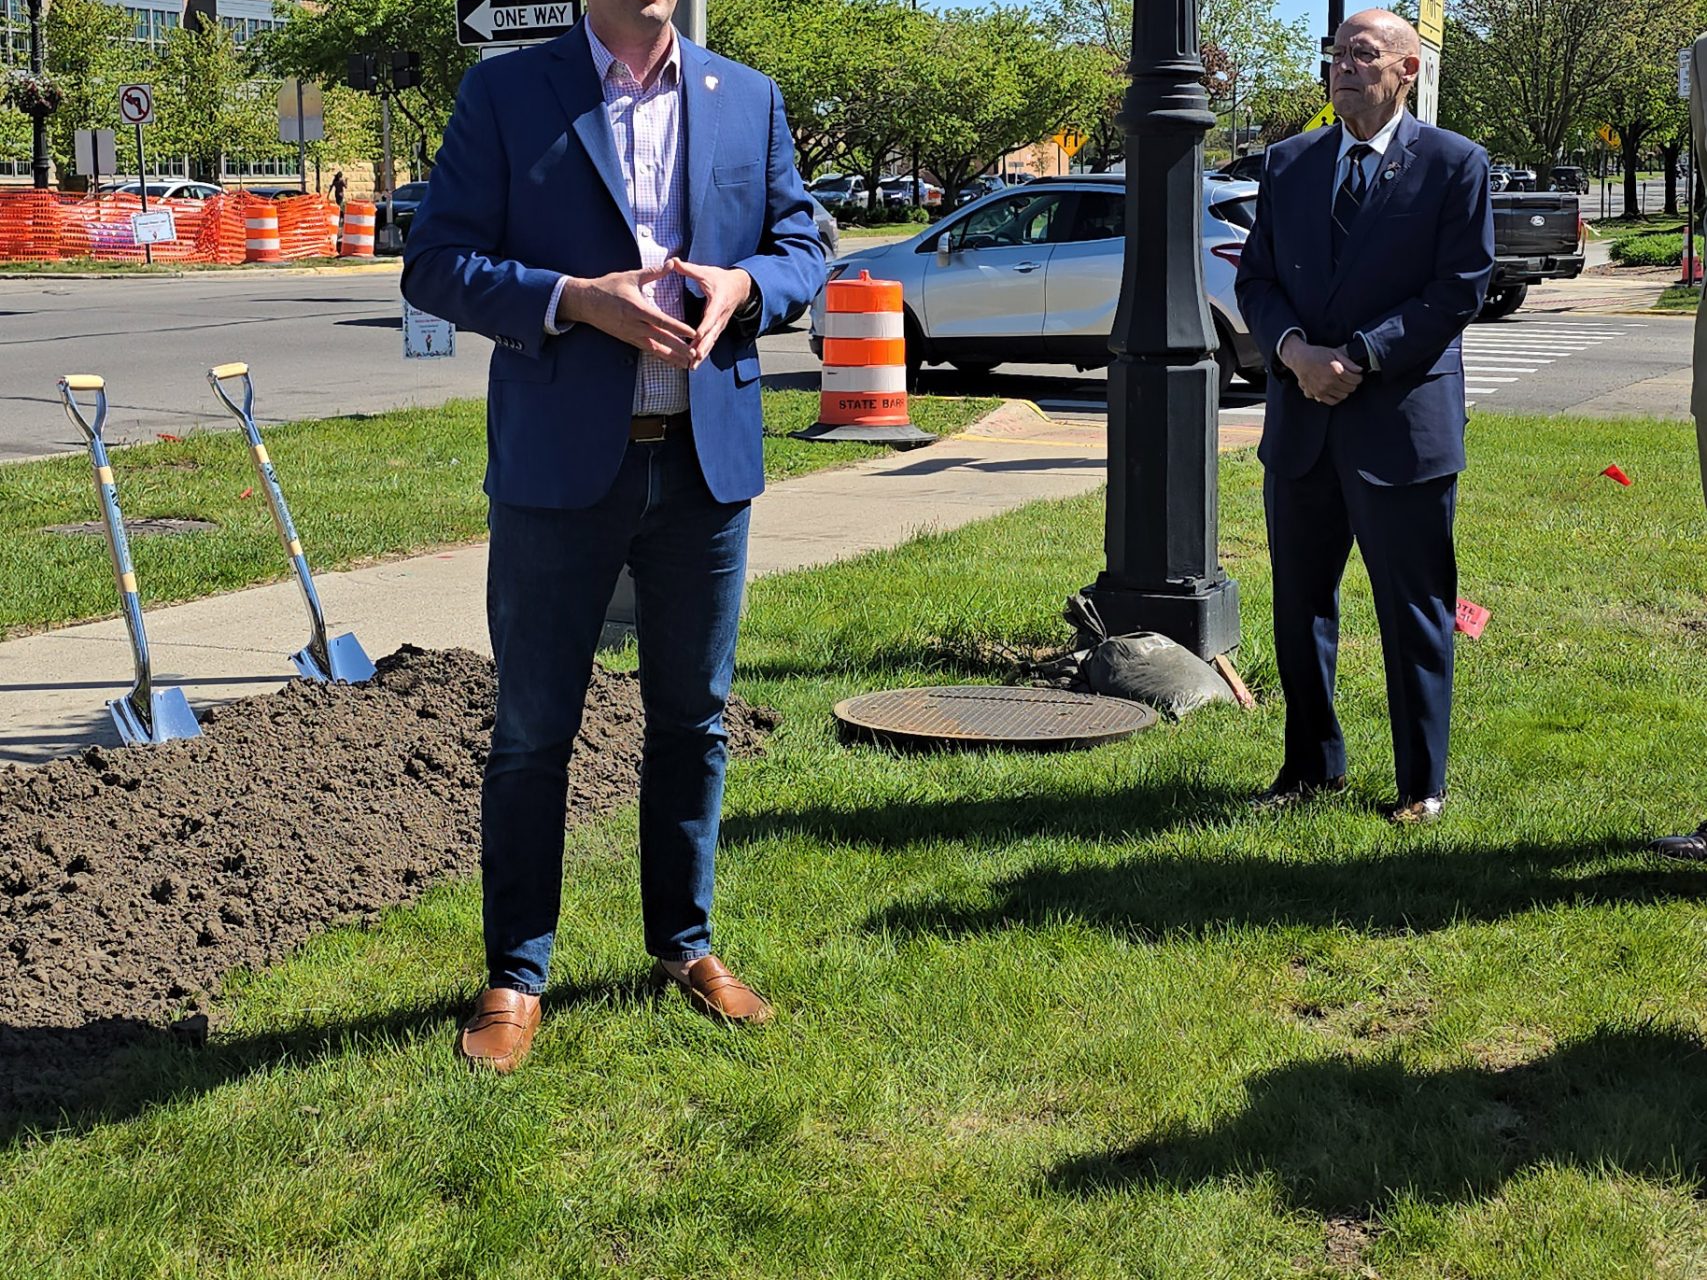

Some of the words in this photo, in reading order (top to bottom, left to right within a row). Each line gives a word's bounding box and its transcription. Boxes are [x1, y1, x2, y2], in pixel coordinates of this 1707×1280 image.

[493, 8, 529, 28] ONE
[534, 5, 568, 25] WAY
[1424, 60, 1434, 86] NO
[839, 399, 877, 410] STATE
